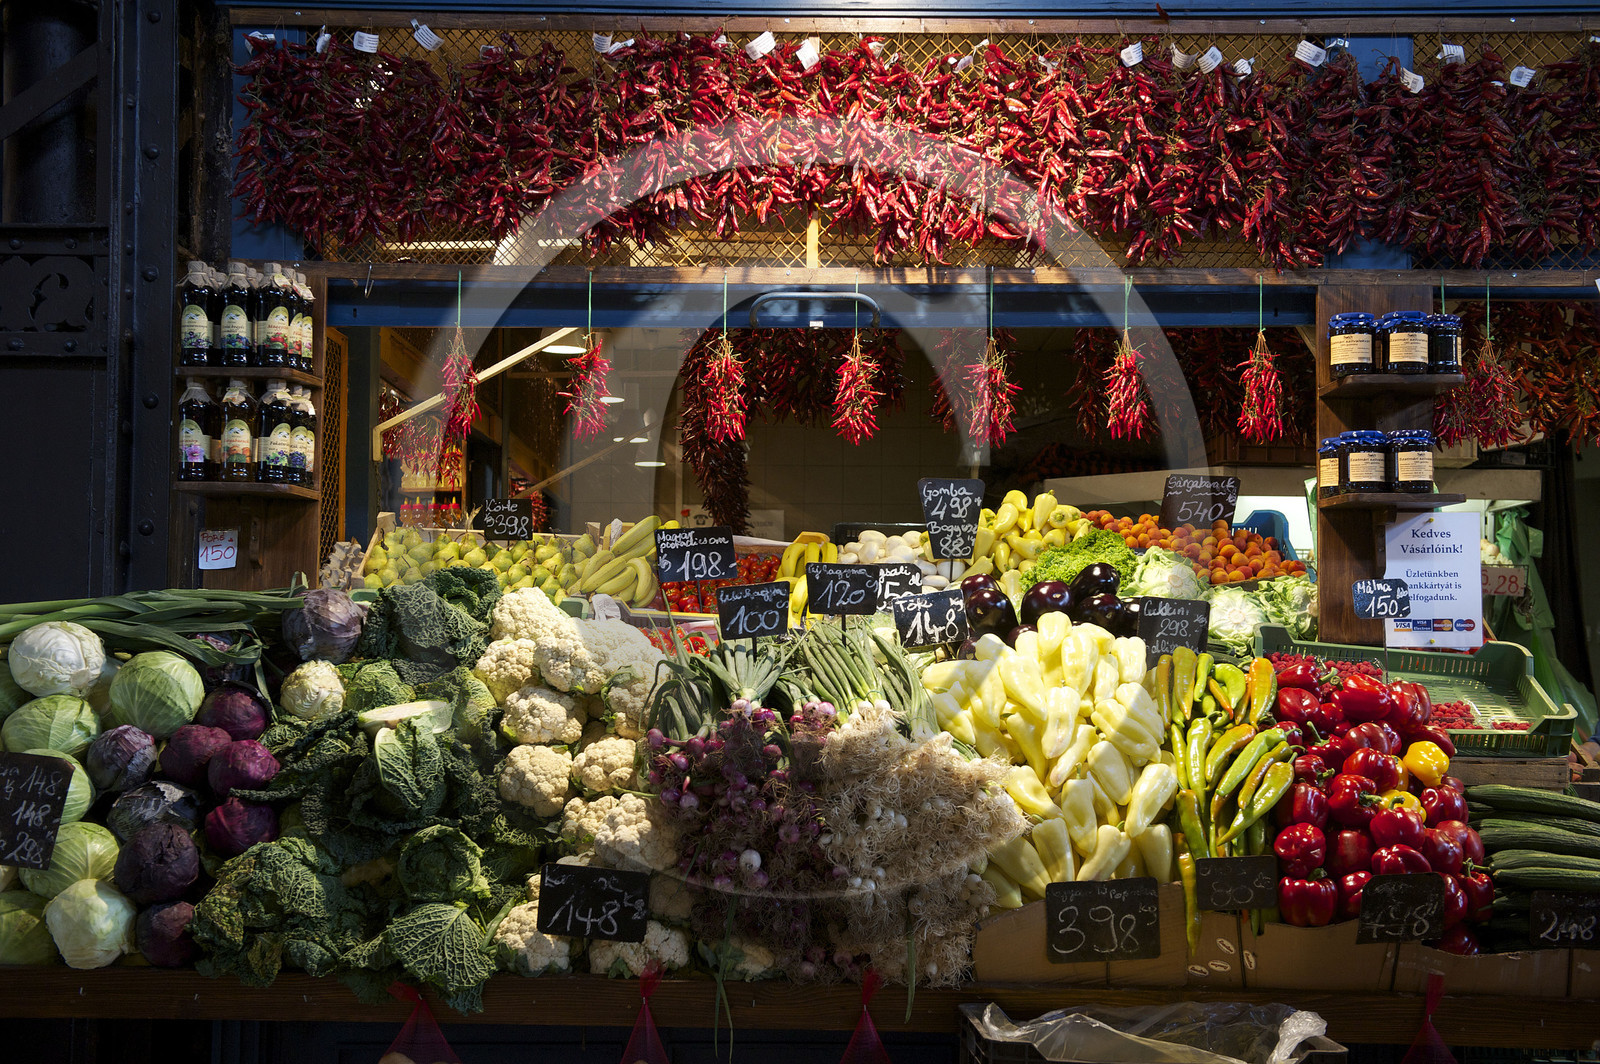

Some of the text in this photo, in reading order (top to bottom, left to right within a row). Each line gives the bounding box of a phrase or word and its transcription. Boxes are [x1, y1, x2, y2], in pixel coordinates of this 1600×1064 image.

[923, 482, 973, 501] Gomba
[485, 499, 518, 512] Körte
[931, 496, 972, 520] 498
[1411, 528, 1451, 539] Kedves
[200, 544, 235, 562] 150
[1400, 544, 1463, 554] Vásárlóink!
[1405, 568, 1459, 578] Üzletünkben
[816, 580, 866, 609] 120
[1357, 579, 1393, 594] Málna
[1407, 583, 1453, 592] ankkártyát
[726, 605, 780, 635] 100
[905, 608, 959, 645] 148
[546, 894, 622, 936] 148
[1051, 905, 1140, 954] 398
